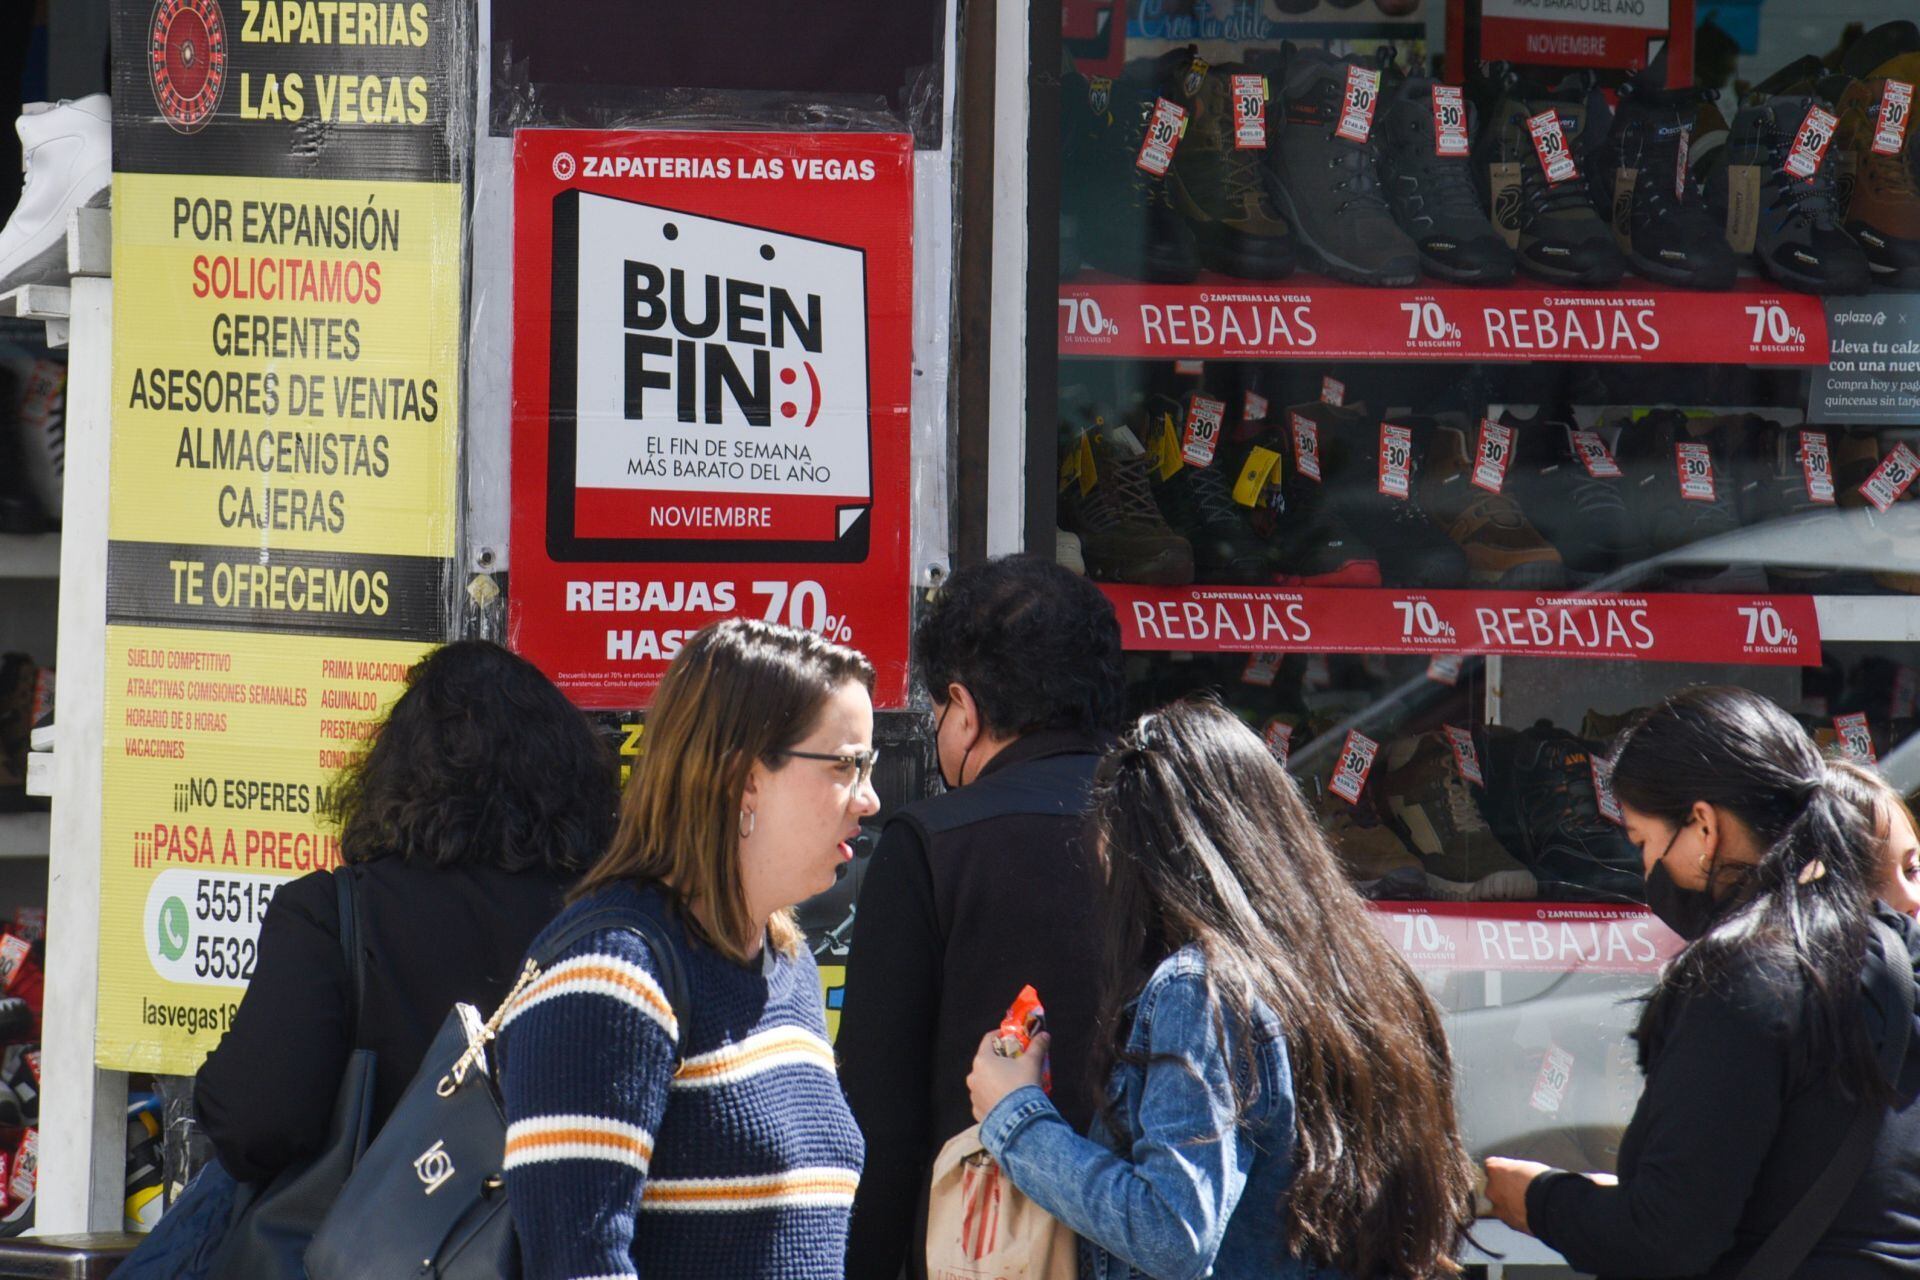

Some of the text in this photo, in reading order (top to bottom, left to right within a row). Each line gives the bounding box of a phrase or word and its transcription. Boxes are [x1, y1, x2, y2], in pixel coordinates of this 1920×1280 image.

[241, 0, 429, 47] ZAPATERIAS
[1527, 34, 1607, 56] NOVIEMBRE
[240, 73, 428, 124] LAS VEGAS
[583, 156, 876, 181] ZAPATERIAS LAS VEGAS
[173, 194, 400, 252] POR EXPANSIÓN
[193, 255, 381, 305] SOLICITAMOS
[623, 259, 823, 354] BUEN
[1210, 293, 1311, 303] ZAPATERIAS LAS VEGAS
[1554, 298, 1655, 307] ZAPATERIAS LAS VEGAS
[1059, 298, 1118, 336] 70%
[1140, 304, 1317, 346] REBAJAS
[1400, 303, 1461, 340] 70%
[1483, 308, 1660, 351] REBAJAS
[1745, 306, 1806, 344] 70%
[1834, 310, 1872, 326] aplazo
[212, 313, 360, 361] GERENTES
[1074, 336, 1112, 344] DESCUENTO
[1831, 339, 1920, 354] Lleva tu calz
[1829, 361, 1855, 371] con
[1859, 361, 1885, 371] una
[129, 368, 438, 422] ASESORES DE VENTAS
[1825, 395, 1877, 408] quincenas
[1880, 395, 1895, 406] sin
[1827, 379, 1920, 392] Compra hoy y pag
[176, 427, 389, 478] ALMACENISTAS
[647, 437, 811, 461] EL FIN DE SEMANA
[627, 453, 831, 483] MÁS BARATO DEL AÑO
[218, 485, 345, 534] CAJERAS
[650, 506, 771, 528] NOVIEMBRE
[170, 560, 389, 616] TE OFRECEMOS
[1201, 592, 1303, 601] ZAPATERIAS LAS VEGAS
[1546, 598, 1598, 606] ZAPATERIAS
[1618, 599, 1648, 607] VEGAS
[566, 580, 852, 643] REBAJAS 70%
[1132, 601, 1312, 641] REBAJAS
[1393, 601, 1455, 637] 70%
[1476, 608, 1654, 649] REBAJAS
[1738, 607, 1798, 646] 70%
[127, 648, 231, 672] SUELDO COMPETITIVO
[1755, 646, 1798, 654] DESCUENTO
[322, 660, 353, 679] PRIMA
[127, 677, 307, 707] ATRACTIVAS COMISIONES SEMANALES
[321, 689, 377, 711] AGUINALDO
[126, 707, 227, 732] HORARIO DE 8 HORAS
[125, 737, 185, 759] VACACIONES
[320, 750, 346, 768] BONO
[224, 780, 310, 814] ESPERES
[221, 828, 239, 866] A
[196, 878, 276, 924] 55515
[1547, 910, 1650, 920] ZAPATERIAS LAS VEGAS
[1393, 914, 1456, 951] 70%
[1477, 920, 1657, 962] REBAJAS
